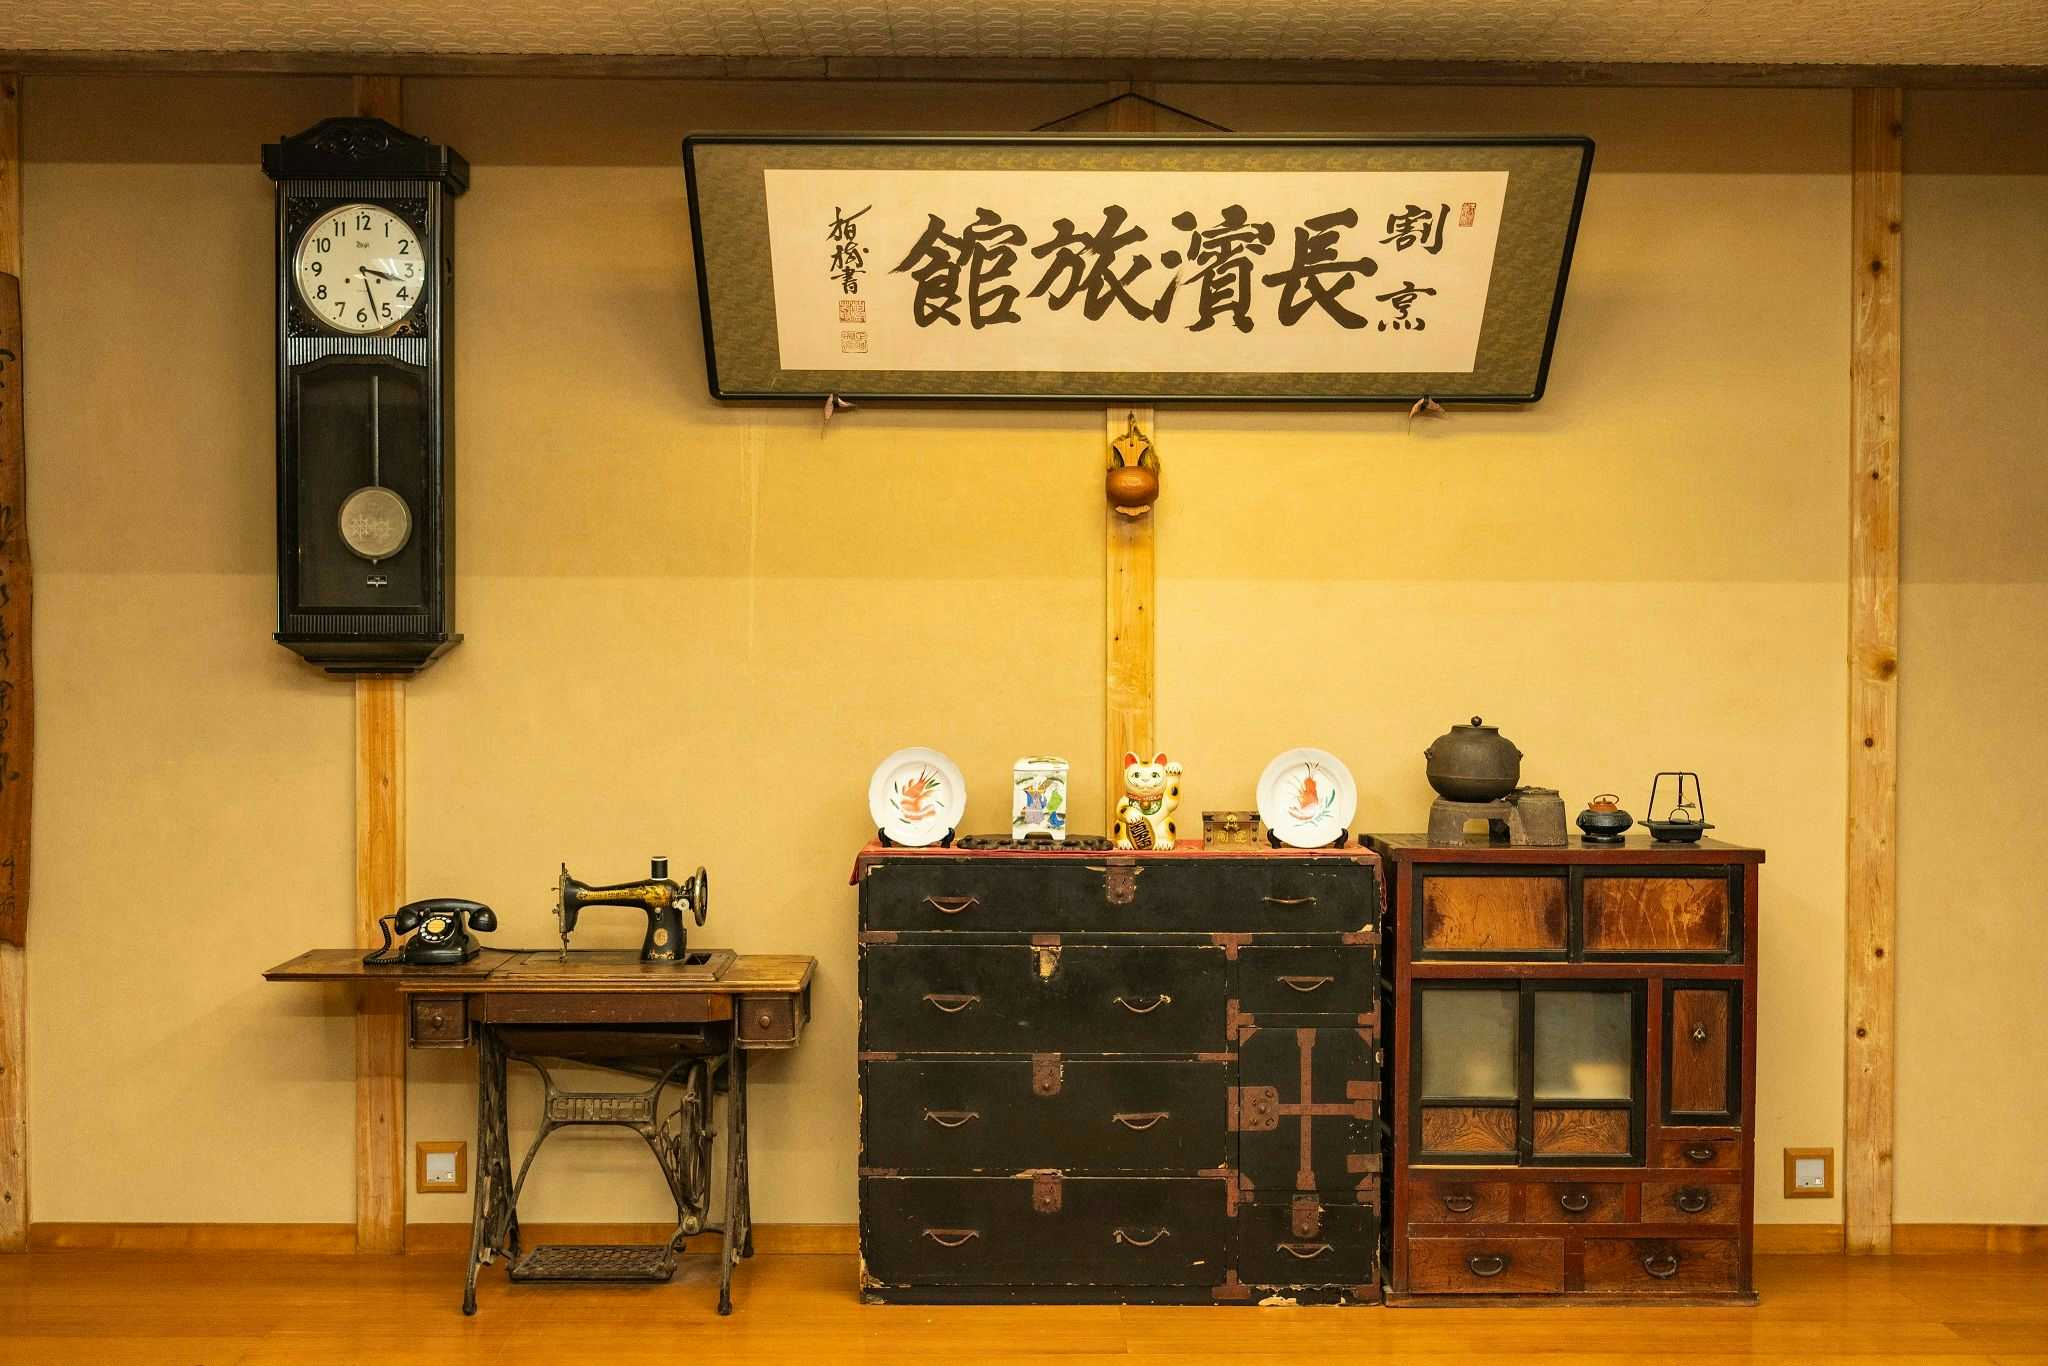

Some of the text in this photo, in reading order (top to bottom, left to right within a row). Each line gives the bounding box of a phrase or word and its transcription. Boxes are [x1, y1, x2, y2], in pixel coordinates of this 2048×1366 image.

[334, 221, 346, 237] 11
[356, 215, 372, 231] 12
[384, 222, 389, 238] 1
[316, 237, 331, 253] 10
[398, 239, 409, 255] 2
[311, 262, 322, 277] 9
[404, 263, 414, 278] 3
[316, 285, 327, 300] 8
[396, 286, 409, 301] 4
[335, 302, 346, 318] 7
[356, 308, 368, 323] 6
[381, 303, 392, 318] 5
